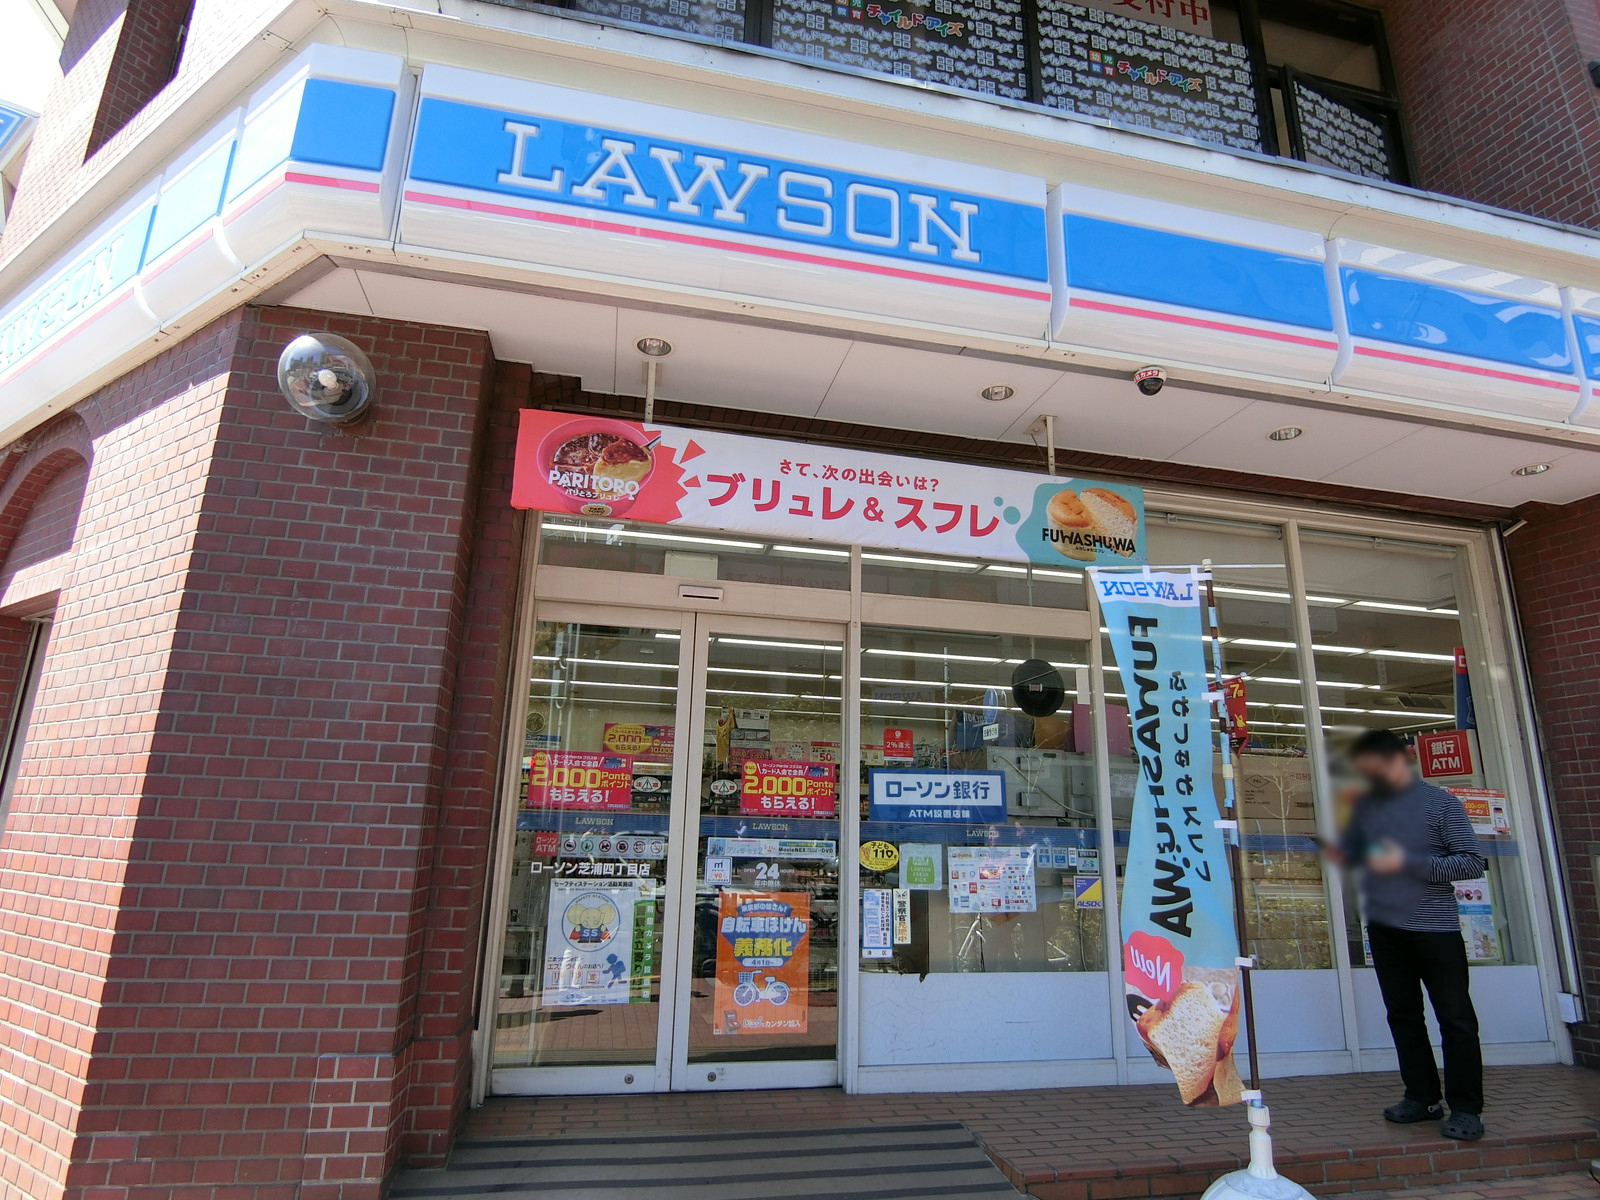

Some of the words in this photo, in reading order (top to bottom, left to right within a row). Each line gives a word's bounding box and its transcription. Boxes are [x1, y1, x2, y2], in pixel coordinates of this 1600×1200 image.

[497, 121, 981, 263] LAWSON
[779, 458, 940, 492] さて、次の出会いは?
[1430, 740, 1455, 756] 銀行
[1431, 756, 1461, 771] ATM
[531, 766, 601, 788] 2,000
[601, 771, 631, 781] Ponta
[601, 780, 631, 789] ポイント
[743, 776, 807, 796] 2,000
[806, 780, 834, 788] Ponta
[885, 780, 990, 800] ローソン銀行
[550, 788, 610, 803] もらえる!
[806, 788, 834, 796] ポイント
[760, 796, 815, 810] もらえる!
[908, 809, 971, 819] ATM設置店舗
[575, 817, 615, 826] LAWSON
[752, 823, 788, 831] LAWSON
[966, 829, 1000, 837] LAWSON
[536, 836, 557, 845] ローソン
[870, 842, 890, 850] 子ども
[535, 844, 557, 853] ATM
[530, 861, 651, 877] ローソン芝浦四丁目店
[755, 862, 780, 880] 24
[1076, 900, 1101, 908] ALSOK
[721, 917, 807, 934] 自転車ほけん
[582, 928, 599, 938] SS
[733, 937, 793, 957] 義務化
